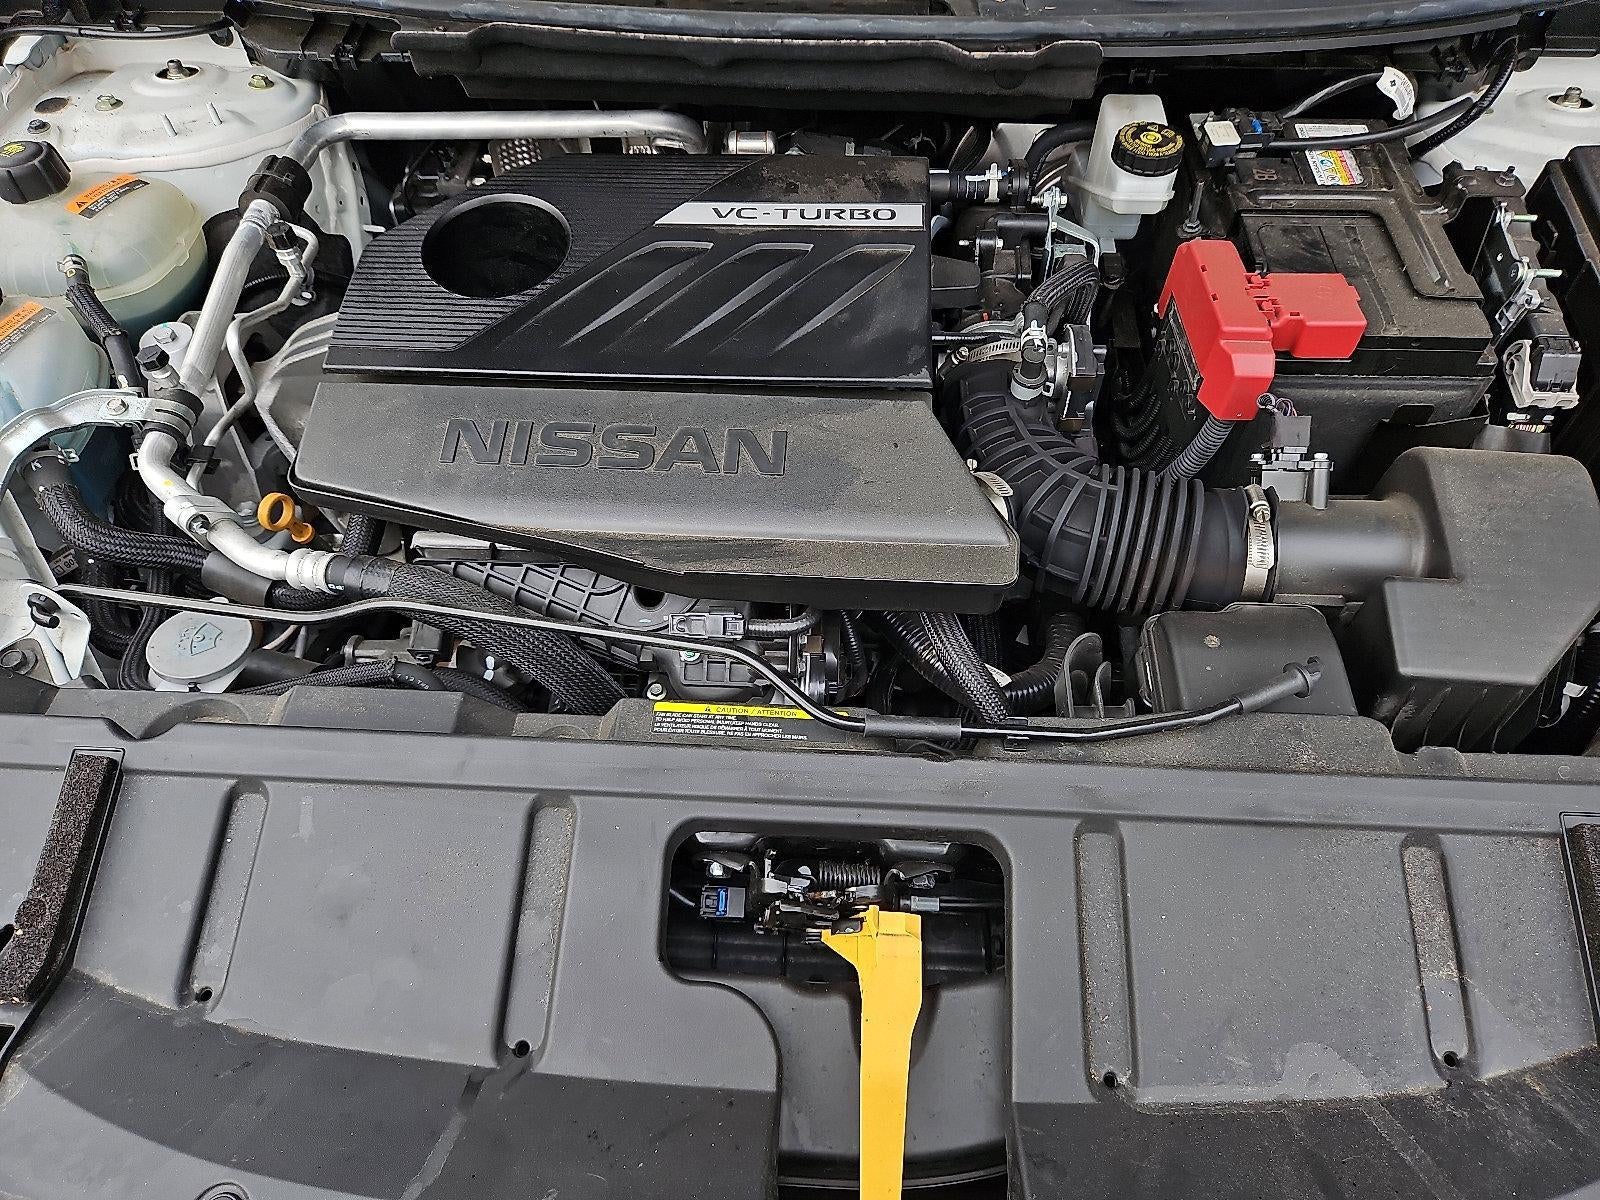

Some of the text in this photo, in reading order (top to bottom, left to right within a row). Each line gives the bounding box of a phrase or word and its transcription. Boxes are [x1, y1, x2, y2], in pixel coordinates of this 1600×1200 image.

[711, 207, 897, 221] VC-TURBO
[438, 418, 788, 476] NISSAN
[715, 706, 749, 714] CAUTION
[757, 708, 797, 717] ATTENTION
